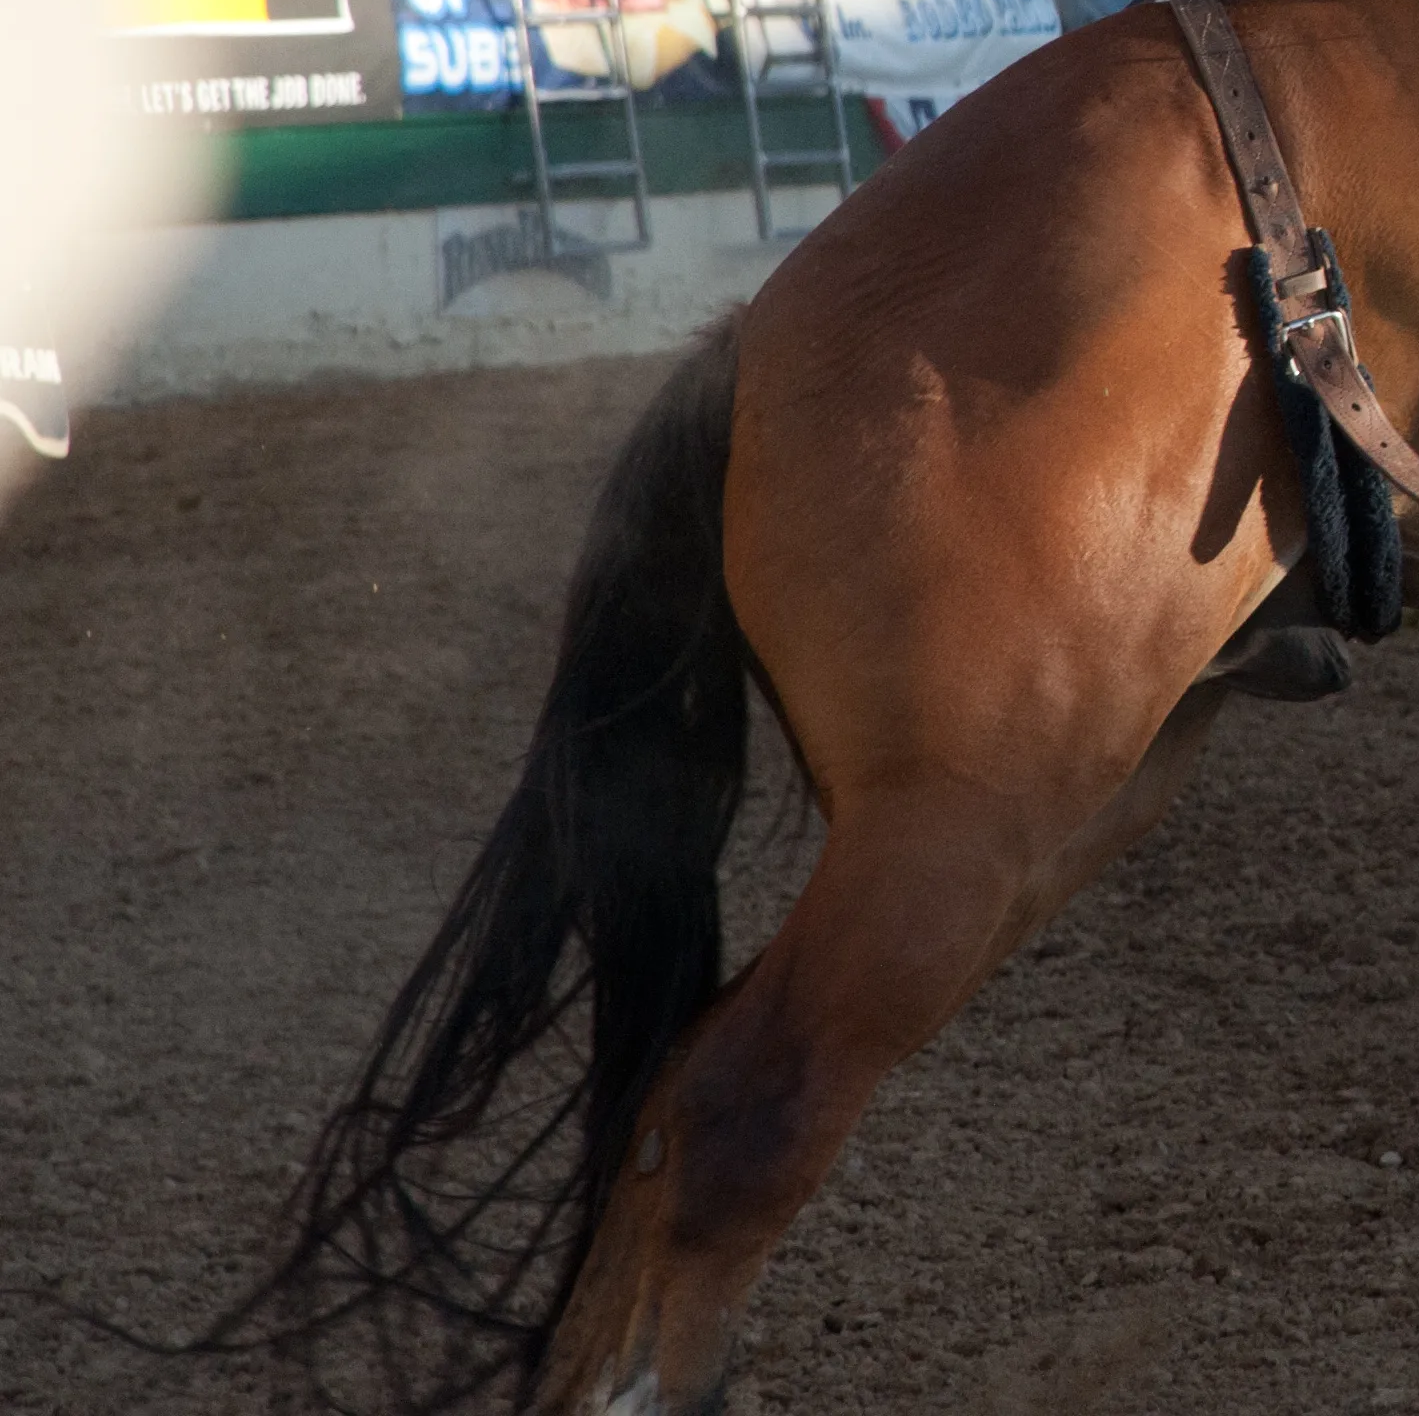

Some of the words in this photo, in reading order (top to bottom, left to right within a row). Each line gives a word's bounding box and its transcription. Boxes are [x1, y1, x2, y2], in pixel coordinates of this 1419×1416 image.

[142, 81, 194, 114] LET'S
[196, 78, 230, 112] GET
[231, 75, 270, 111] THE
[270, 73, 308, 110] JOB
